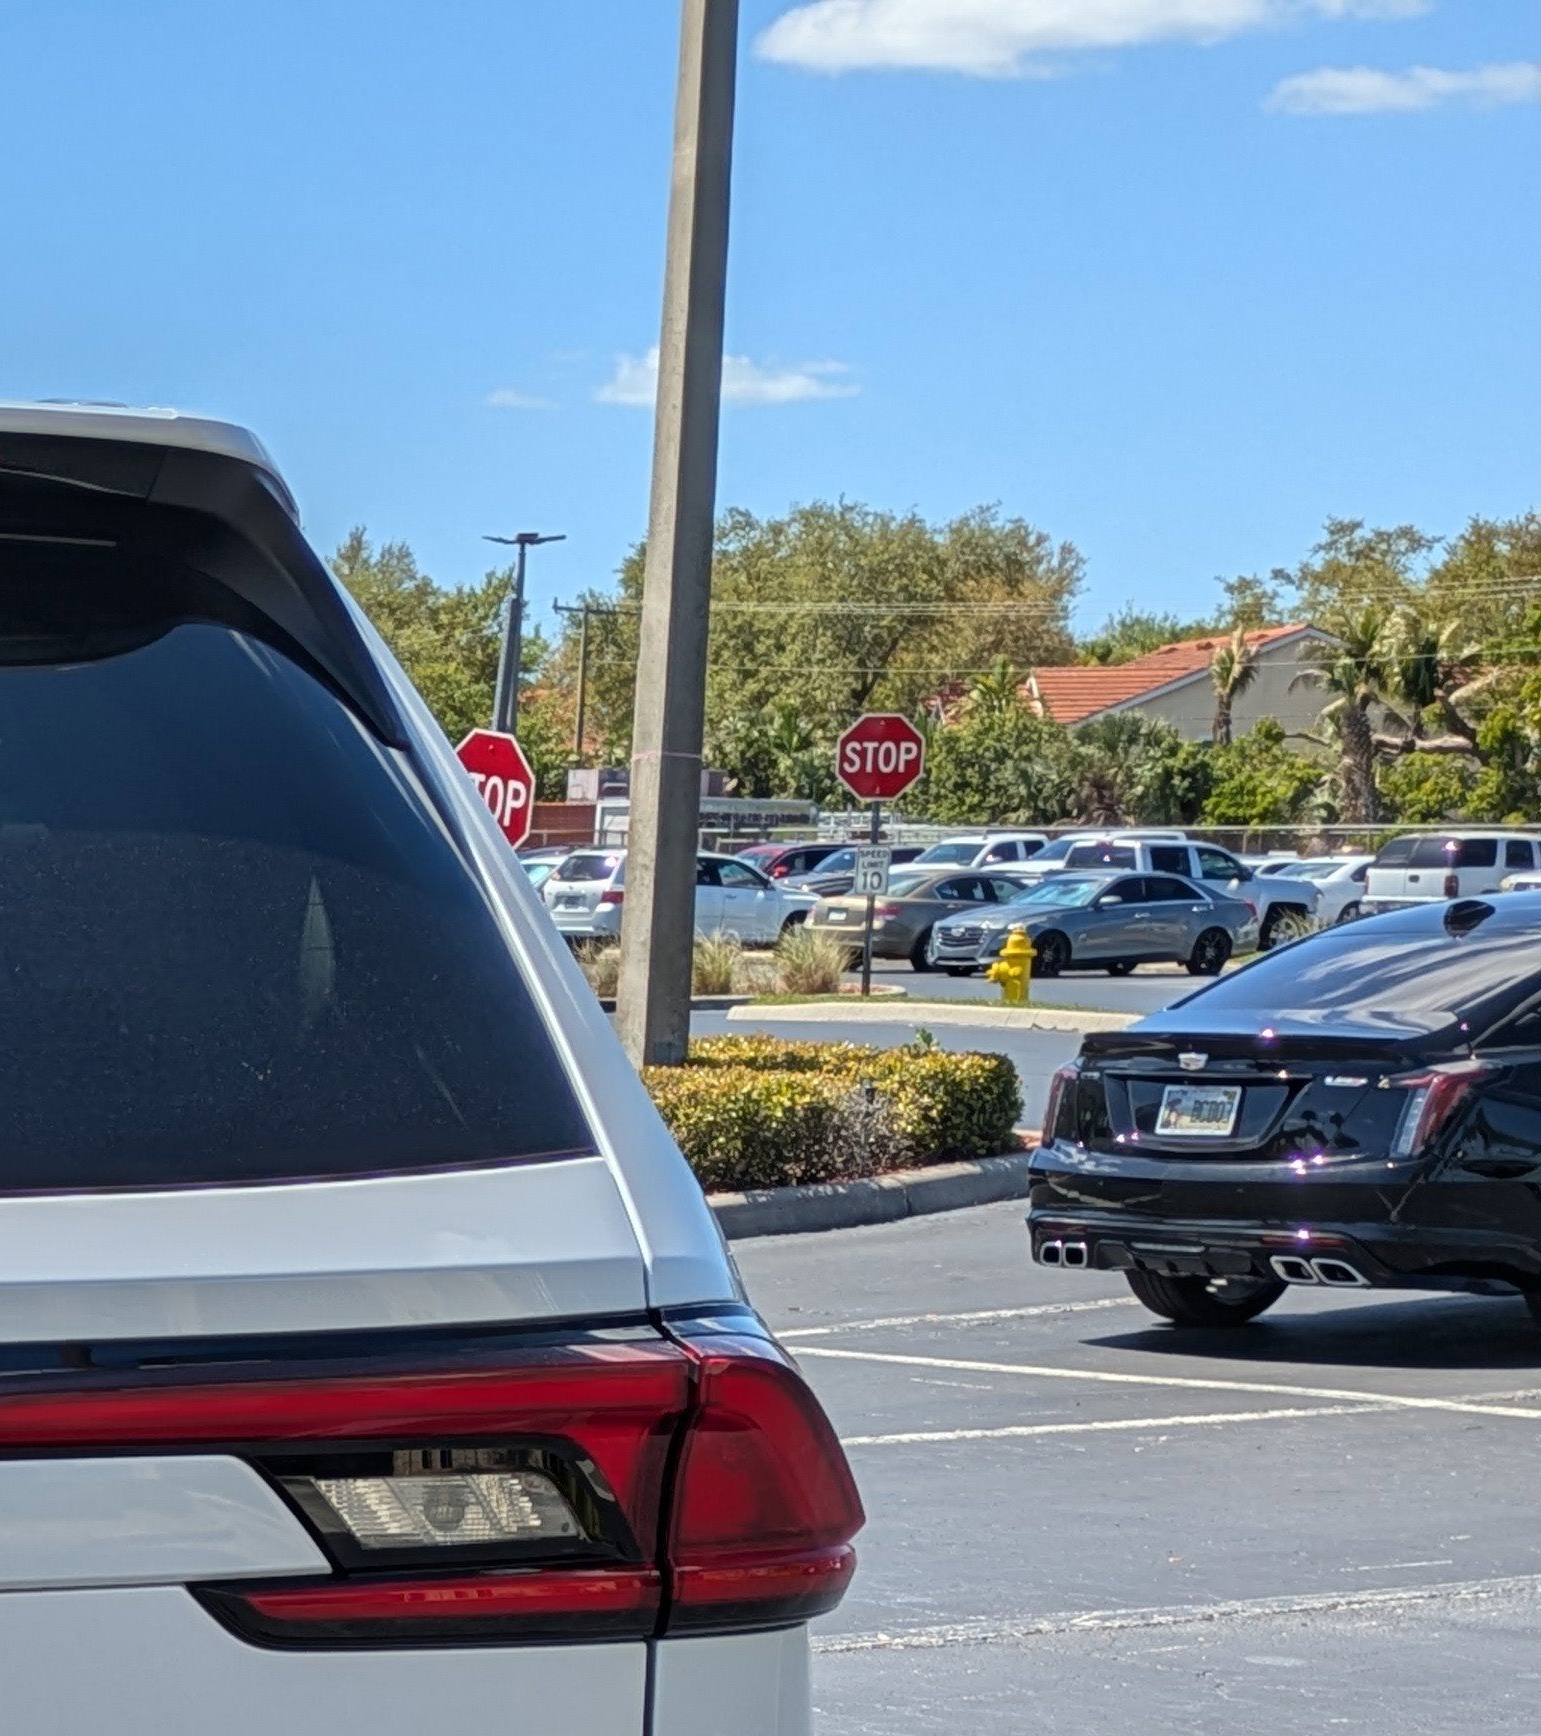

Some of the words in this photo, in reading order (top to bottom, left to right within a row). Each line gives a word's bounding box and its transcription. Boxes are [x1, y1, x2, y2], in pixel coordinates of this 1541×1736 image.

[843, 741, 918, 773] STOP
[468, 772, 527, 827] TOP
[860, 850, 888, 858] SPEED
[862, 861, 884, 869] LIMIT
[862, 871, 882, 890] 10
